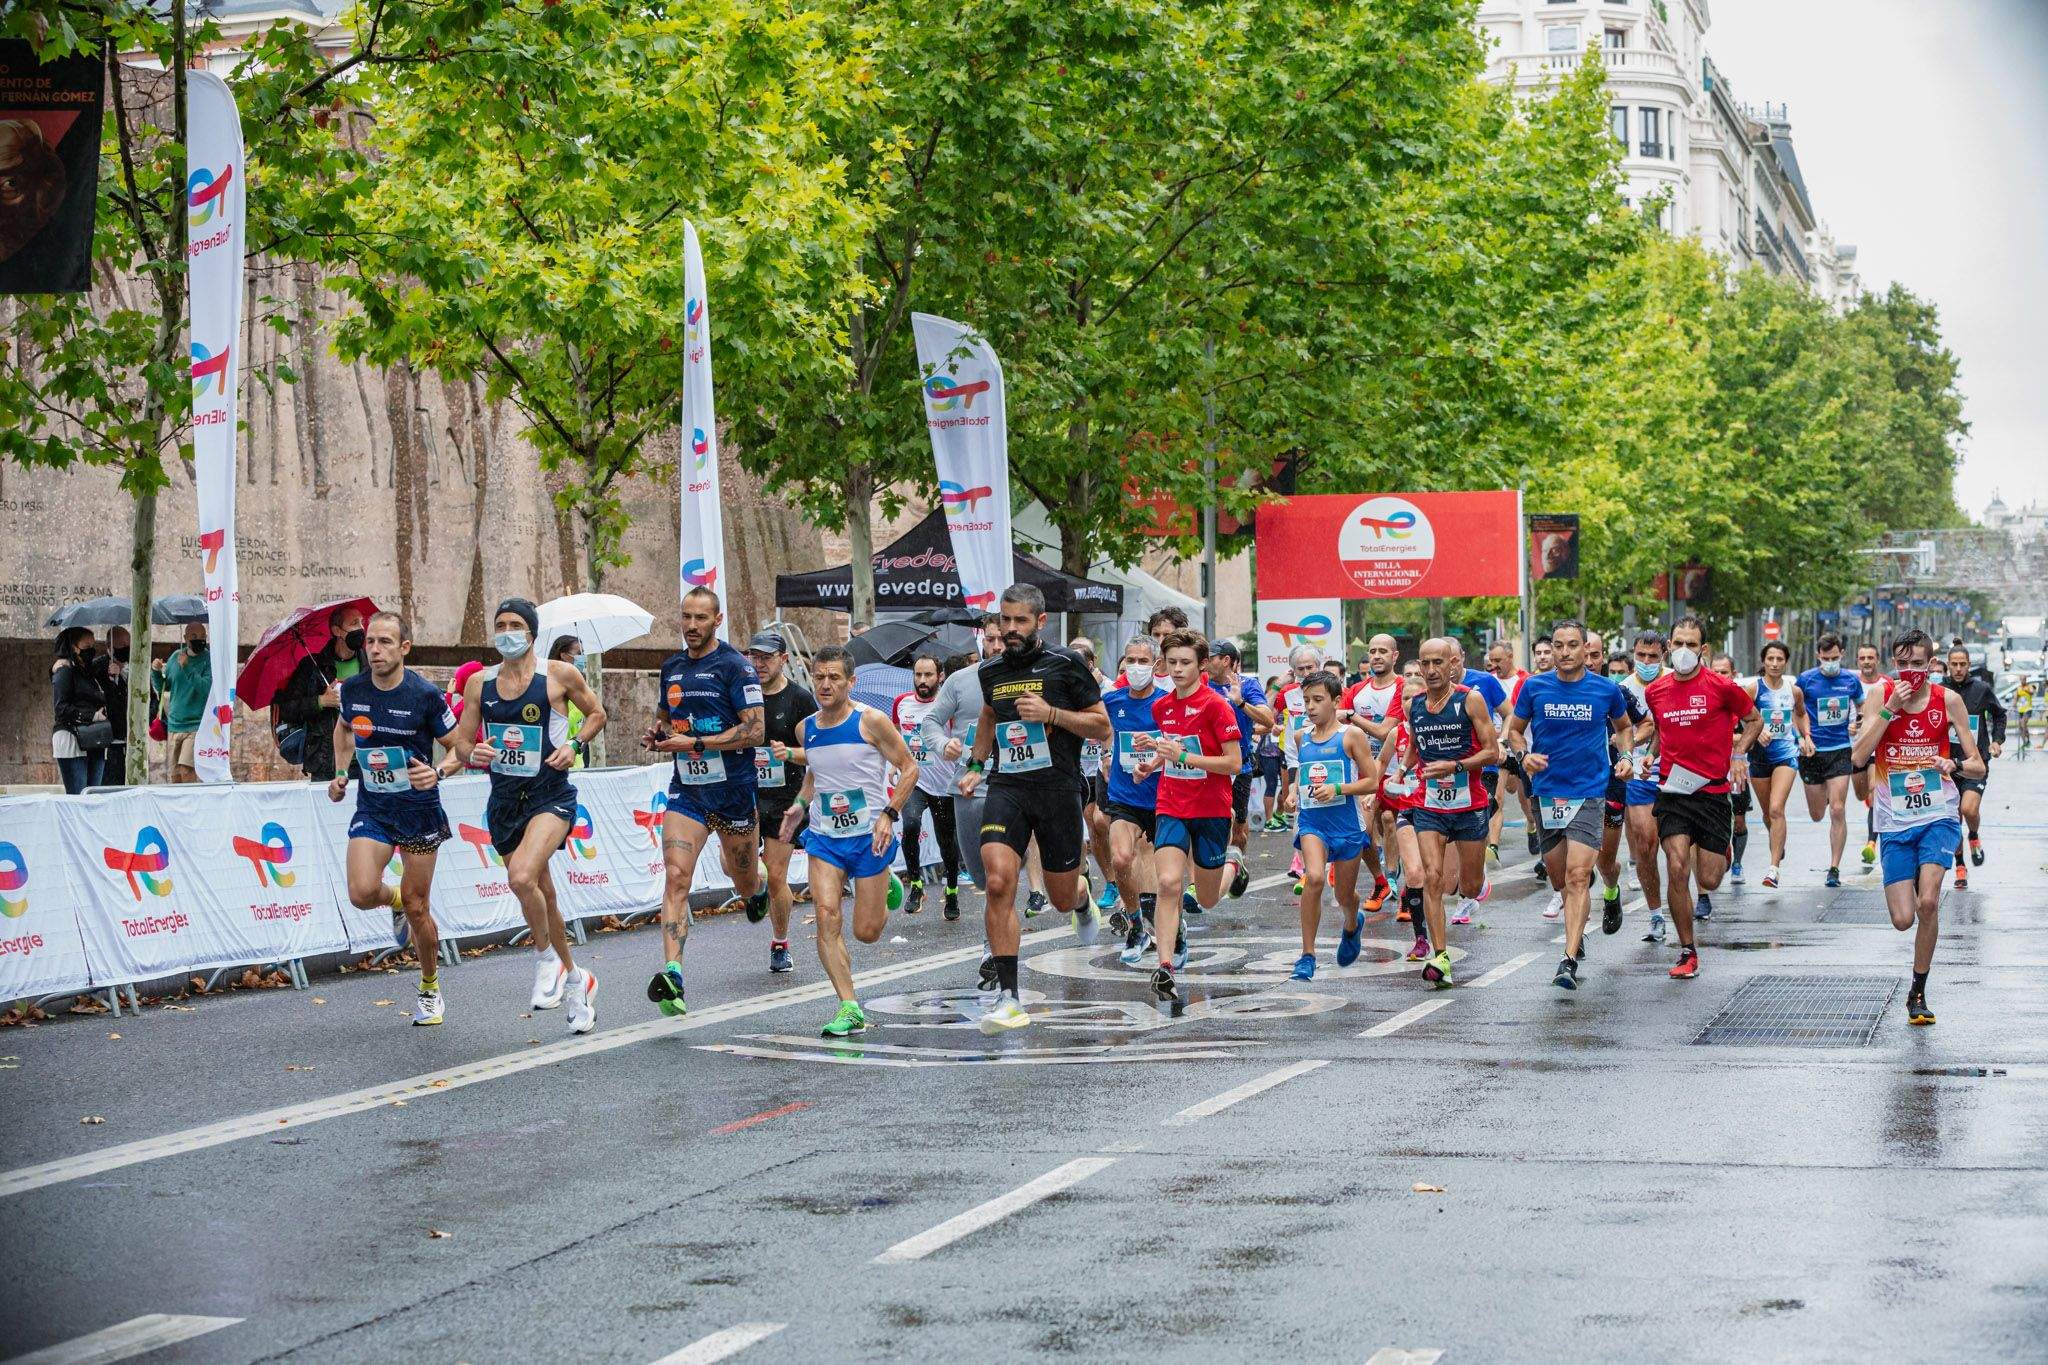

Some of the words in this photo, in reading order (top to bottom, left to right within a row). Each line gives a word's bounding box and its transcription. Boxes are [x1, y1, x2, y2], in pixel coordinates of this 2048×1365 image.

[37, 78, 52, 88] DE
[52, 89, 96, 102] GÓMEZ
[1360, 544, 1417, 554] TotalEnergies
[1373, 561, 1402, 570] MILLA
[1364, 579, 1377, 587] DE
[1378, 578, 1412, 587] MADRID
[1544, 703, 1592, 711] SUBARU
[1663, 711, 1680, 719] SAN
[1680, 708, 1707, 716] PABLO
[1544, 710, 1592, 718] TRIATLON
[1826, 711, 1842, 720] 246
[1769, 724, 1785, 733] 250
[500, 750, 526, 766] 285
[1009, 745, 1034, 763] 284
[687, 760, 709, 775] 133
[370, 769, 395, 784] 283
[1437, 788, 1457, 801] 287
[1905, 792, 1931, 810] 296
[831, 812, 859, 829] 265
[250, 901, 312, 923] TotalEnergies
[122, 910, 190, 938] TotalEnergies
